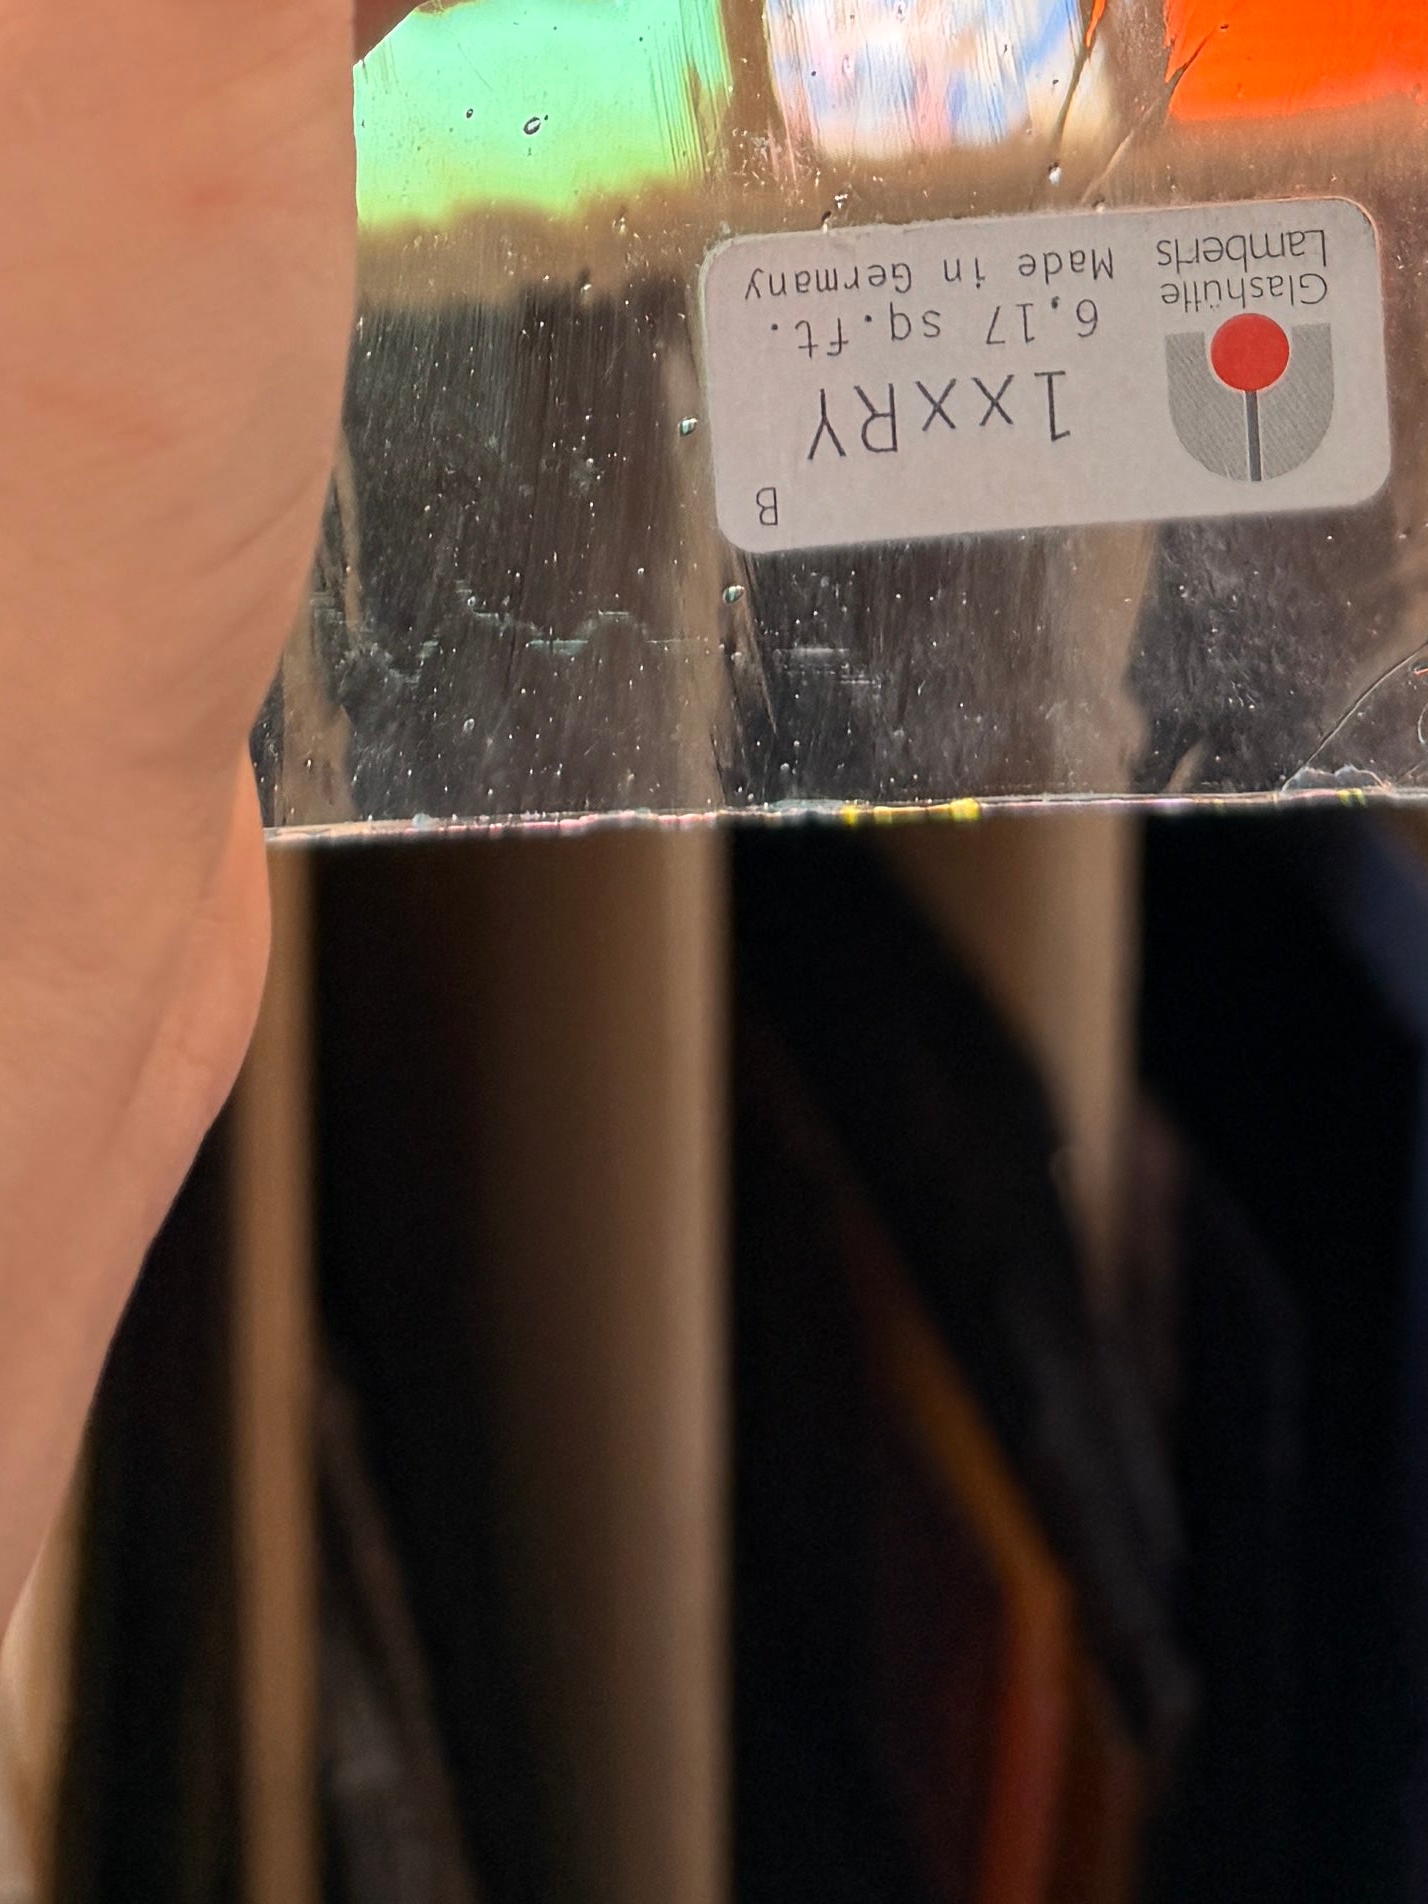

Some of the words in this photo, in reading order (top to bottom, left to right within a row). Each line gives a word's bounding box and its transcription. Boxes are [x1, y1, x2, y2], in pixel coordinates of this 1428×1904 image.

[1018, 246, 1115, 286] Made
[1155, 229, 1327, 275] Lamberts
[744, 261, 913, 301] Germany
[943, 256, 987, 290] in
[1160, 272, 1328, 314] Glashütte
[806, 369, 1071, 462] 1xxRY
[755, 486, 779, 527] B
